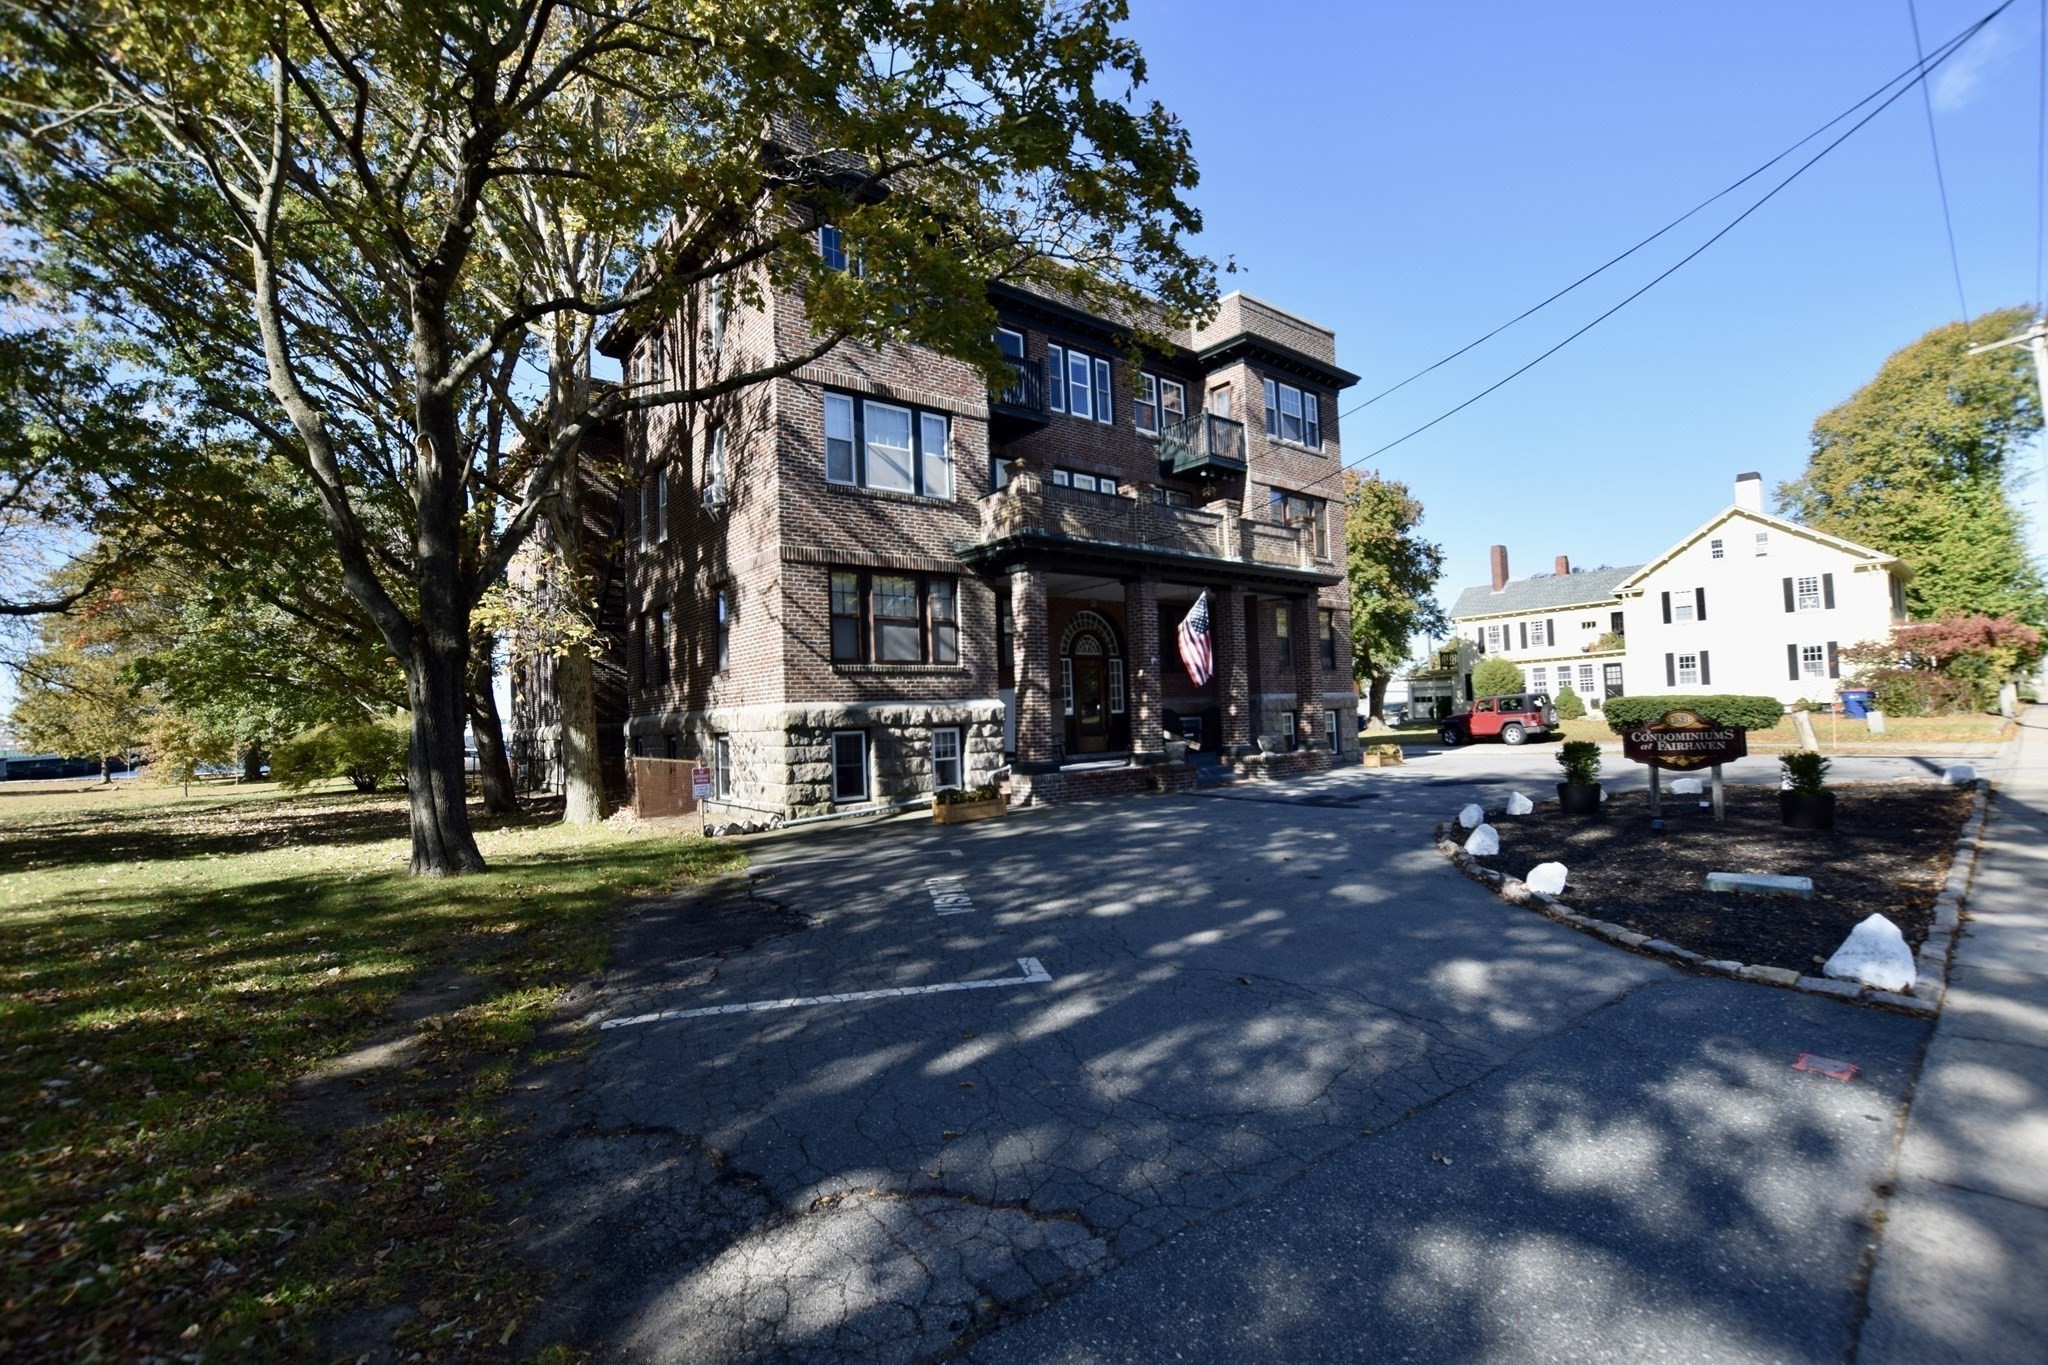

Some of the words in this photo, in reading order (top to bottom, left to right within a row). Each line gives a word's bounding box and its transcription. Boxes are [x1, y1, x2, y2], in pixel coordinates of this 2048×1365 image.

[1631, 729, 1734, 742] CONDOMINIUMS
[1640, 742, 1653, 750] at
[1657, 740, 1726, 751] FAIRHAVEN
